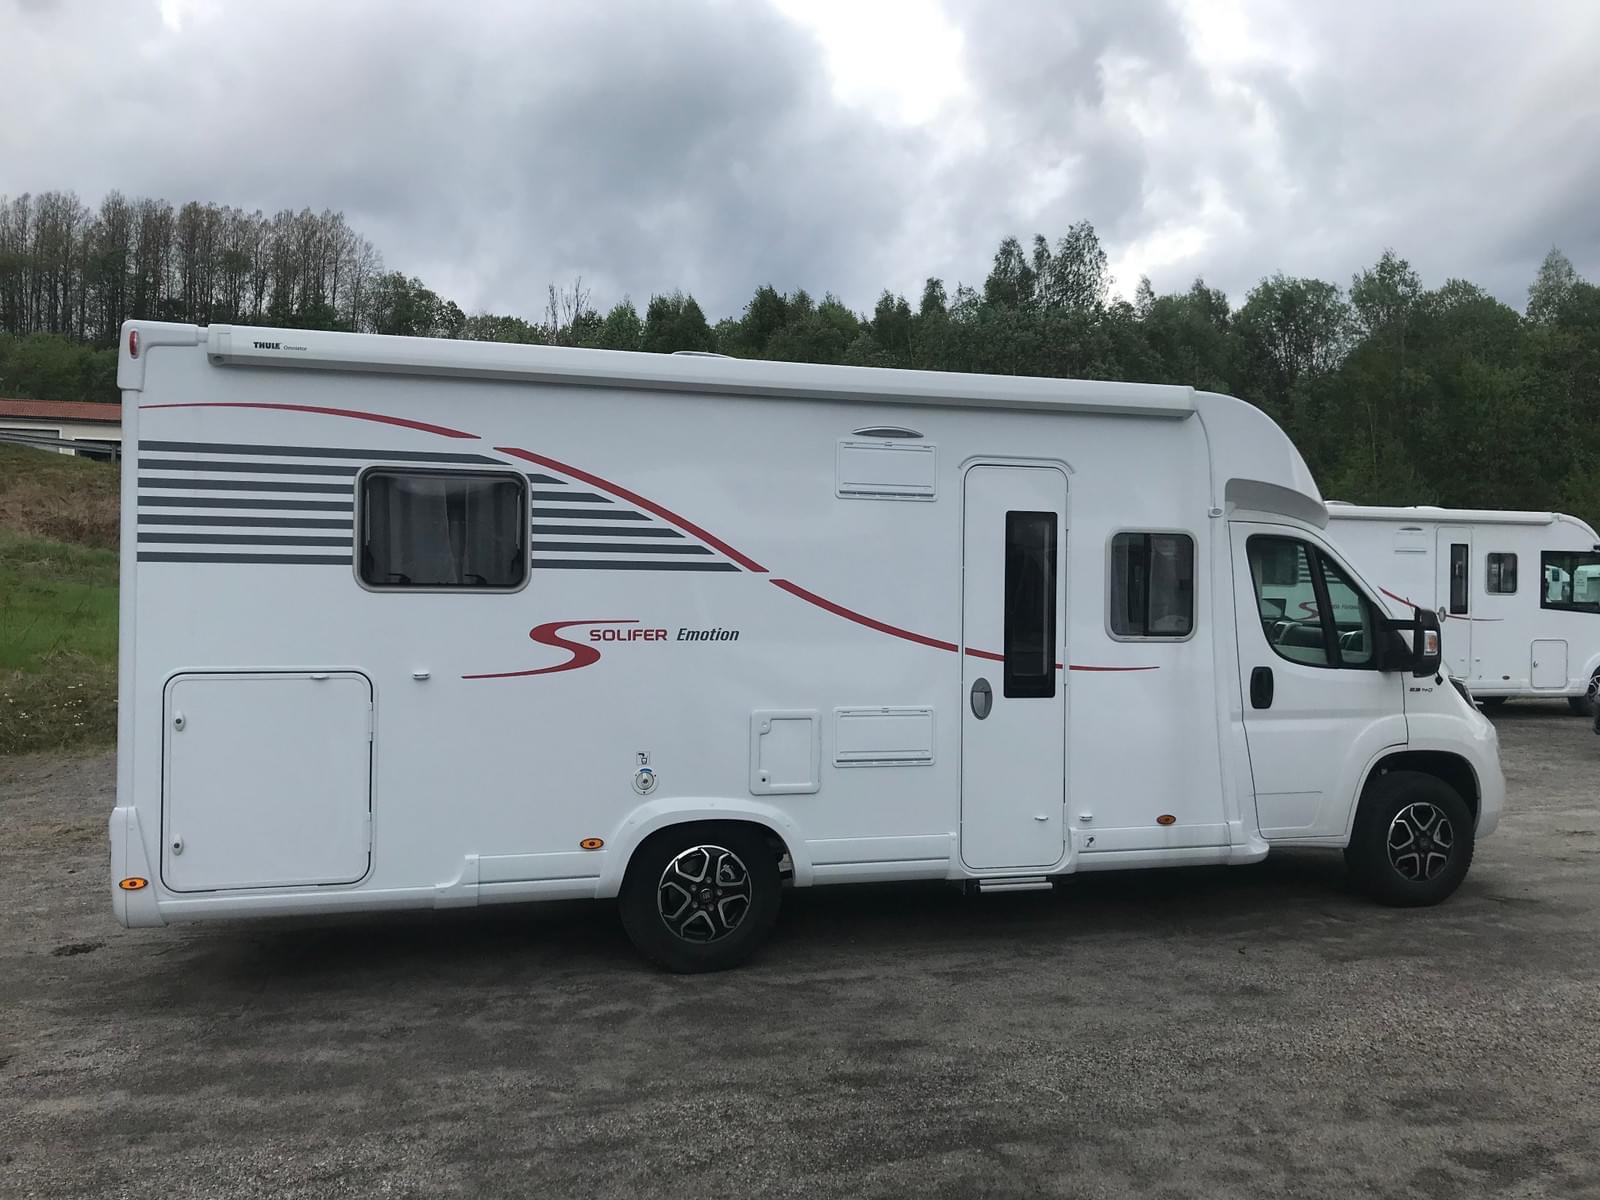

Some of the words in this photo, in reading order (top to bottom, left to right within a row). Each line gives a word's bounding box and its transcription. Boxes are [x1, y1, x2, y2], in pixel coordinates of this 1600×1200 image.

[253, 341, 281, 350] THULE
[589, 629, 668, 642] SOLIFER
[676, 627, 740, 642] Emotion
